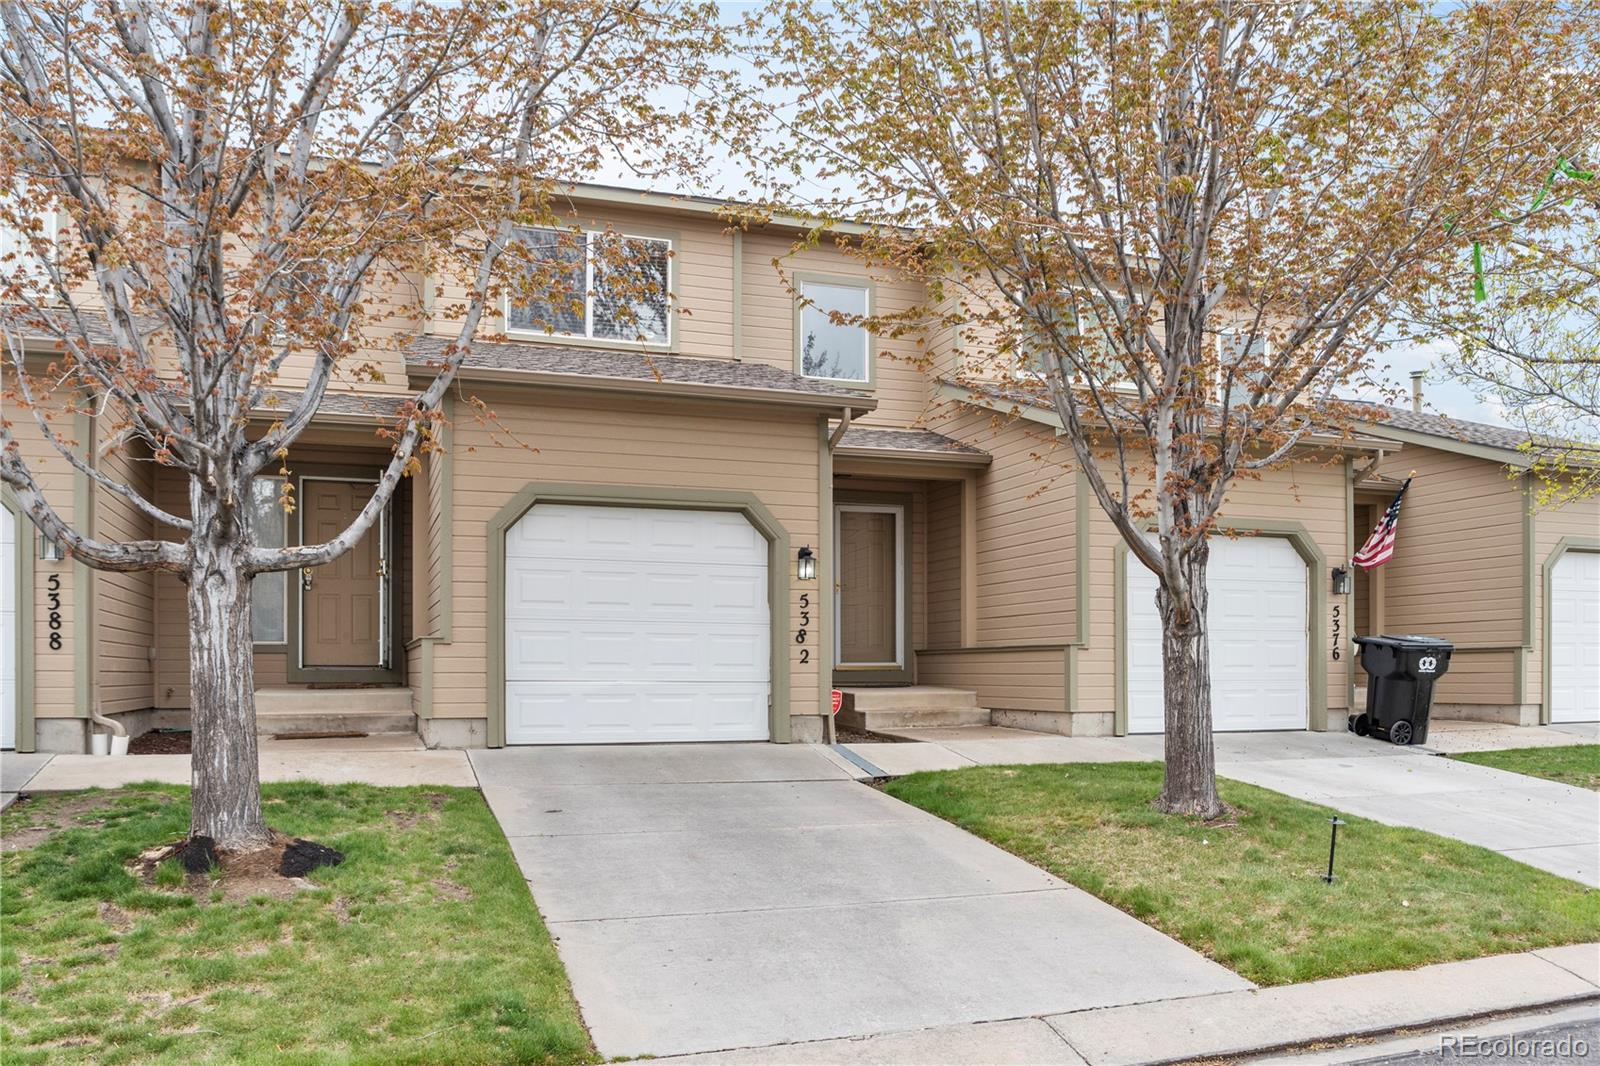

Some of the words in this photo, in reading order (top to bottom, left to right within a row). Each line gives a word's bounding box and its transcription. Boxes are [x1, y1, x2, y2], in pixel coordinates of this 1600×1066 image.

[48, 574, 62, 650] 5388
[796, 593, 809, 664] 5382
[1332, 605, 1340, 660] 5376
